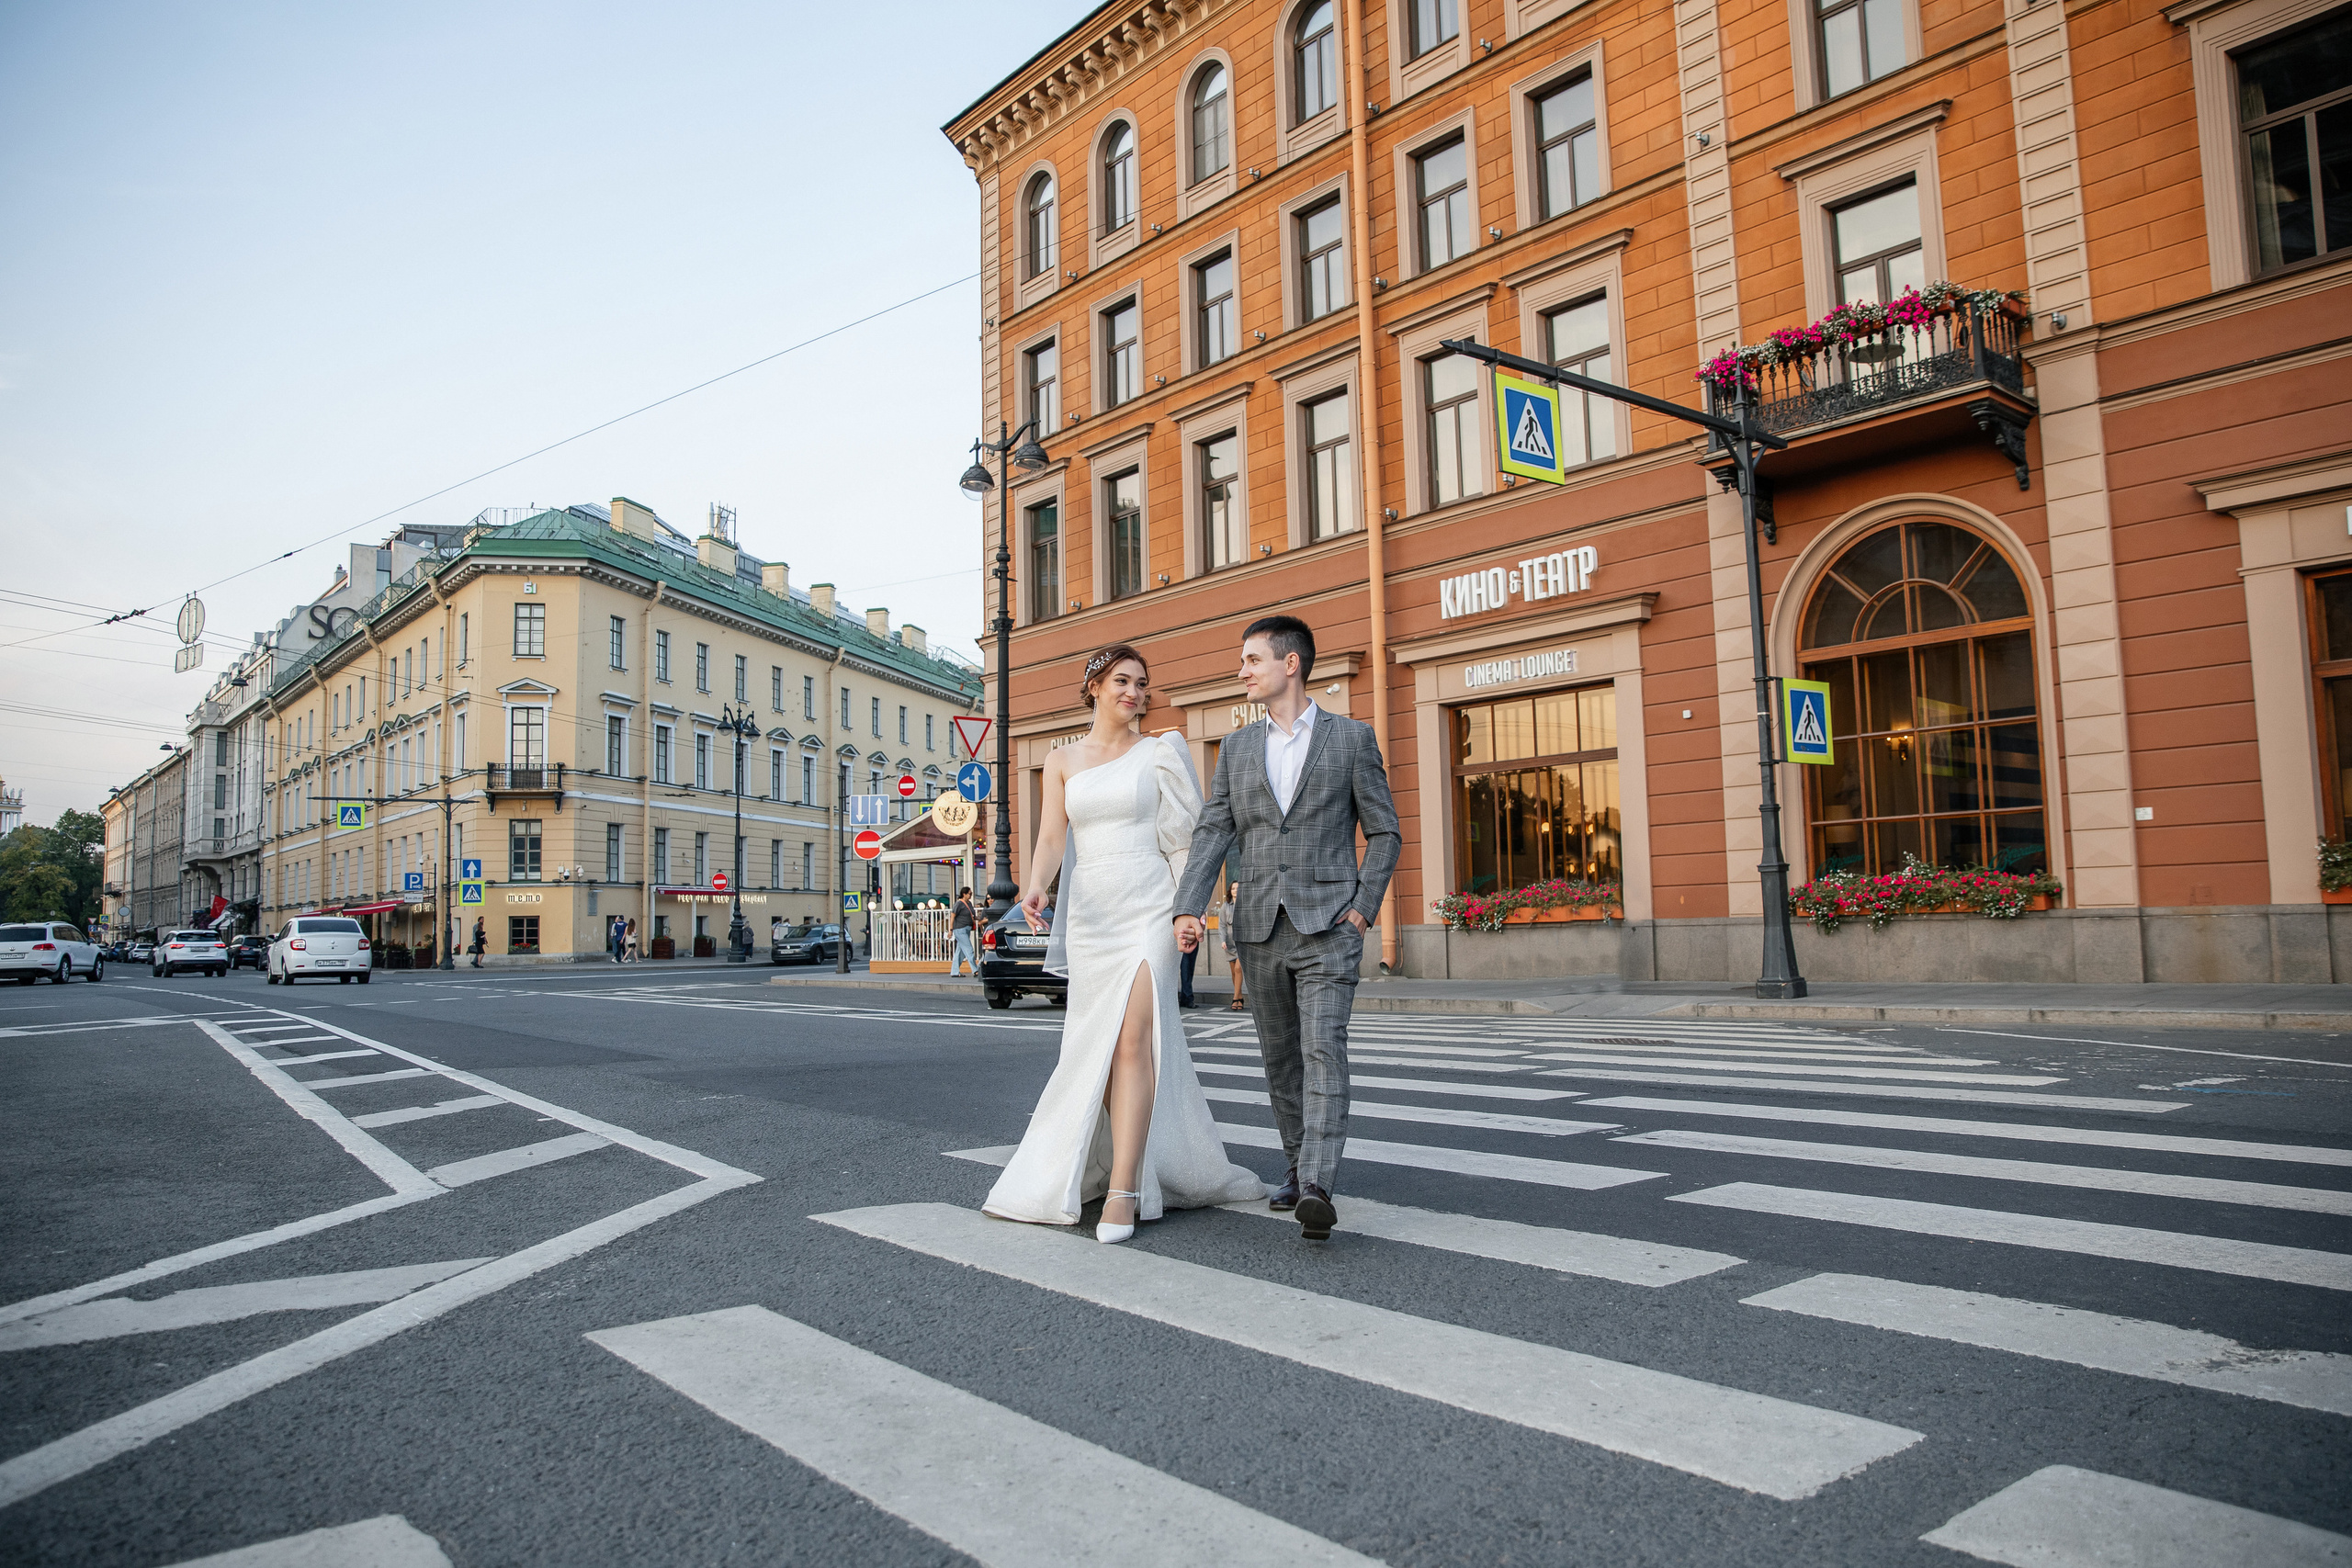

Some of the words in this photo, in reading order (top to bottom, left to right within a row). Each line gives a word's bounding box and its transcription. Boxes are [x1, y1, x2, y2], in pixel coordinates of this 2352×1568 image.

[1440, 567, 1508, 620] КИНО
[1518, 546, 1599, 603] ТЕАТР
[1464, 659, 1514, 688] CINEMA
[1521, 649, 1576, 679] LOUNGE
[507, 894, 541, 902] memo
